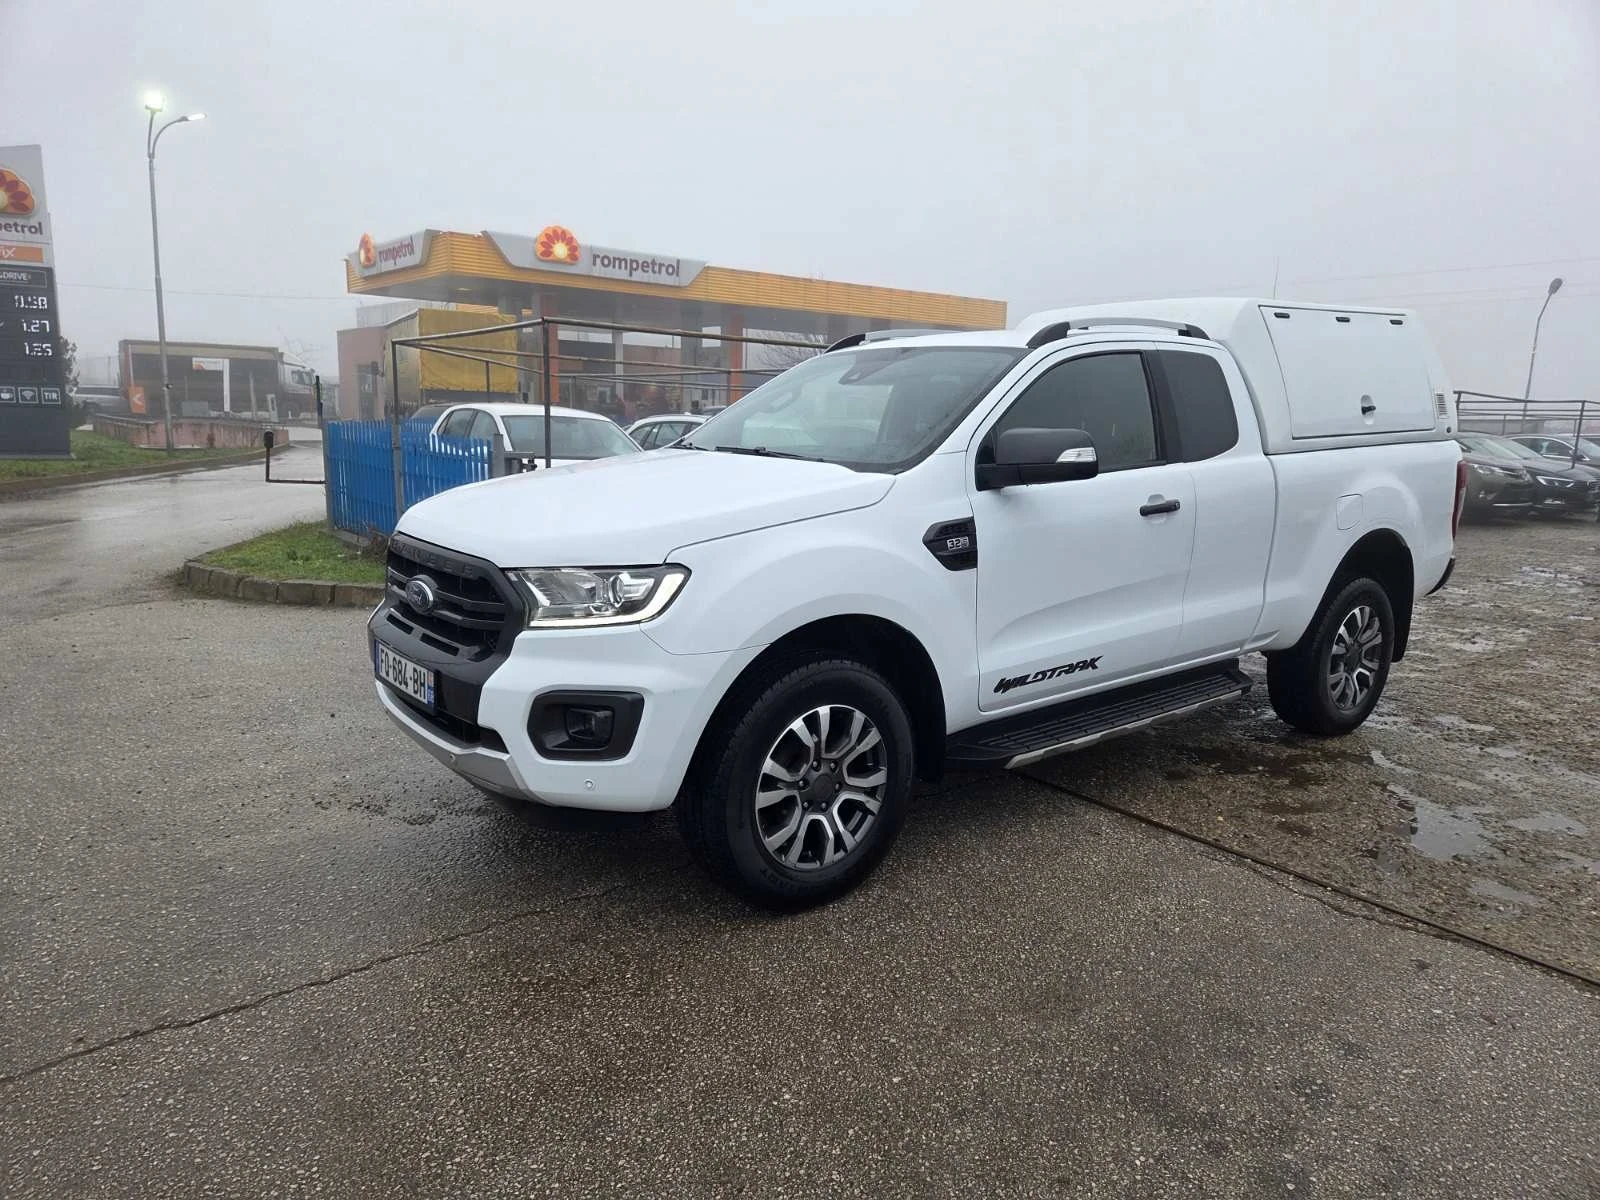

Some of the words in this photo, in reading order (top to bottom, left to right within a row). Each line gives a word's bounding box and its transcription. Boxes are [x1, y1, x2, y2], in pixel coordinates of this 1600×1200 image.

[592, 254, 680, 277] rompetrol
[22, 319, 50, 332] 1.27
[44, 392, 58, 400] TIR
[993, 655, 1104, 694] WILDTRAK
